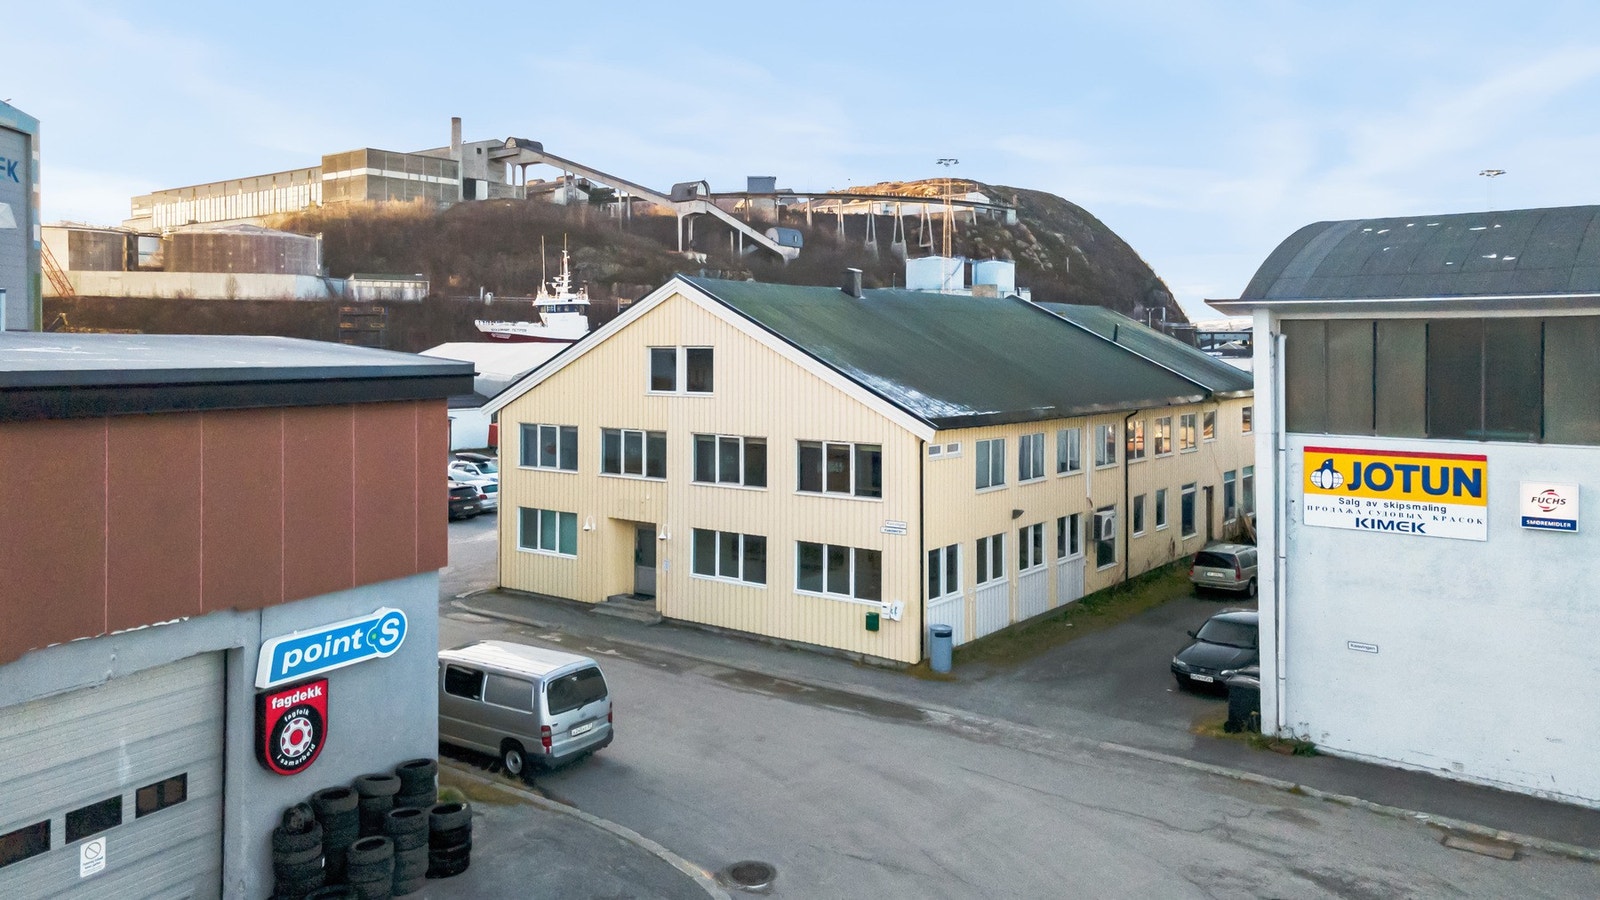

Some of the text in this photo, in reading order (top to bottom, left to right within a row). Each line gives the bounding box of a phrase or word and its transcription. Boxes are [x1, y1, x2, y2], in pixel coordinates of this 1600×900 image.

[1347, 461, 1482, 498] JOTUN
[1338, 497, 1360, 507] Salg
[1383, 501, 1447, 514] skipsmaling
[1531, 496, 1567, 505] FUCHS
[1355, 517, 1426, 533] KIMEK
[282, 617, 400, 675] point S
[271, 685, 322, 709] fagdekk
